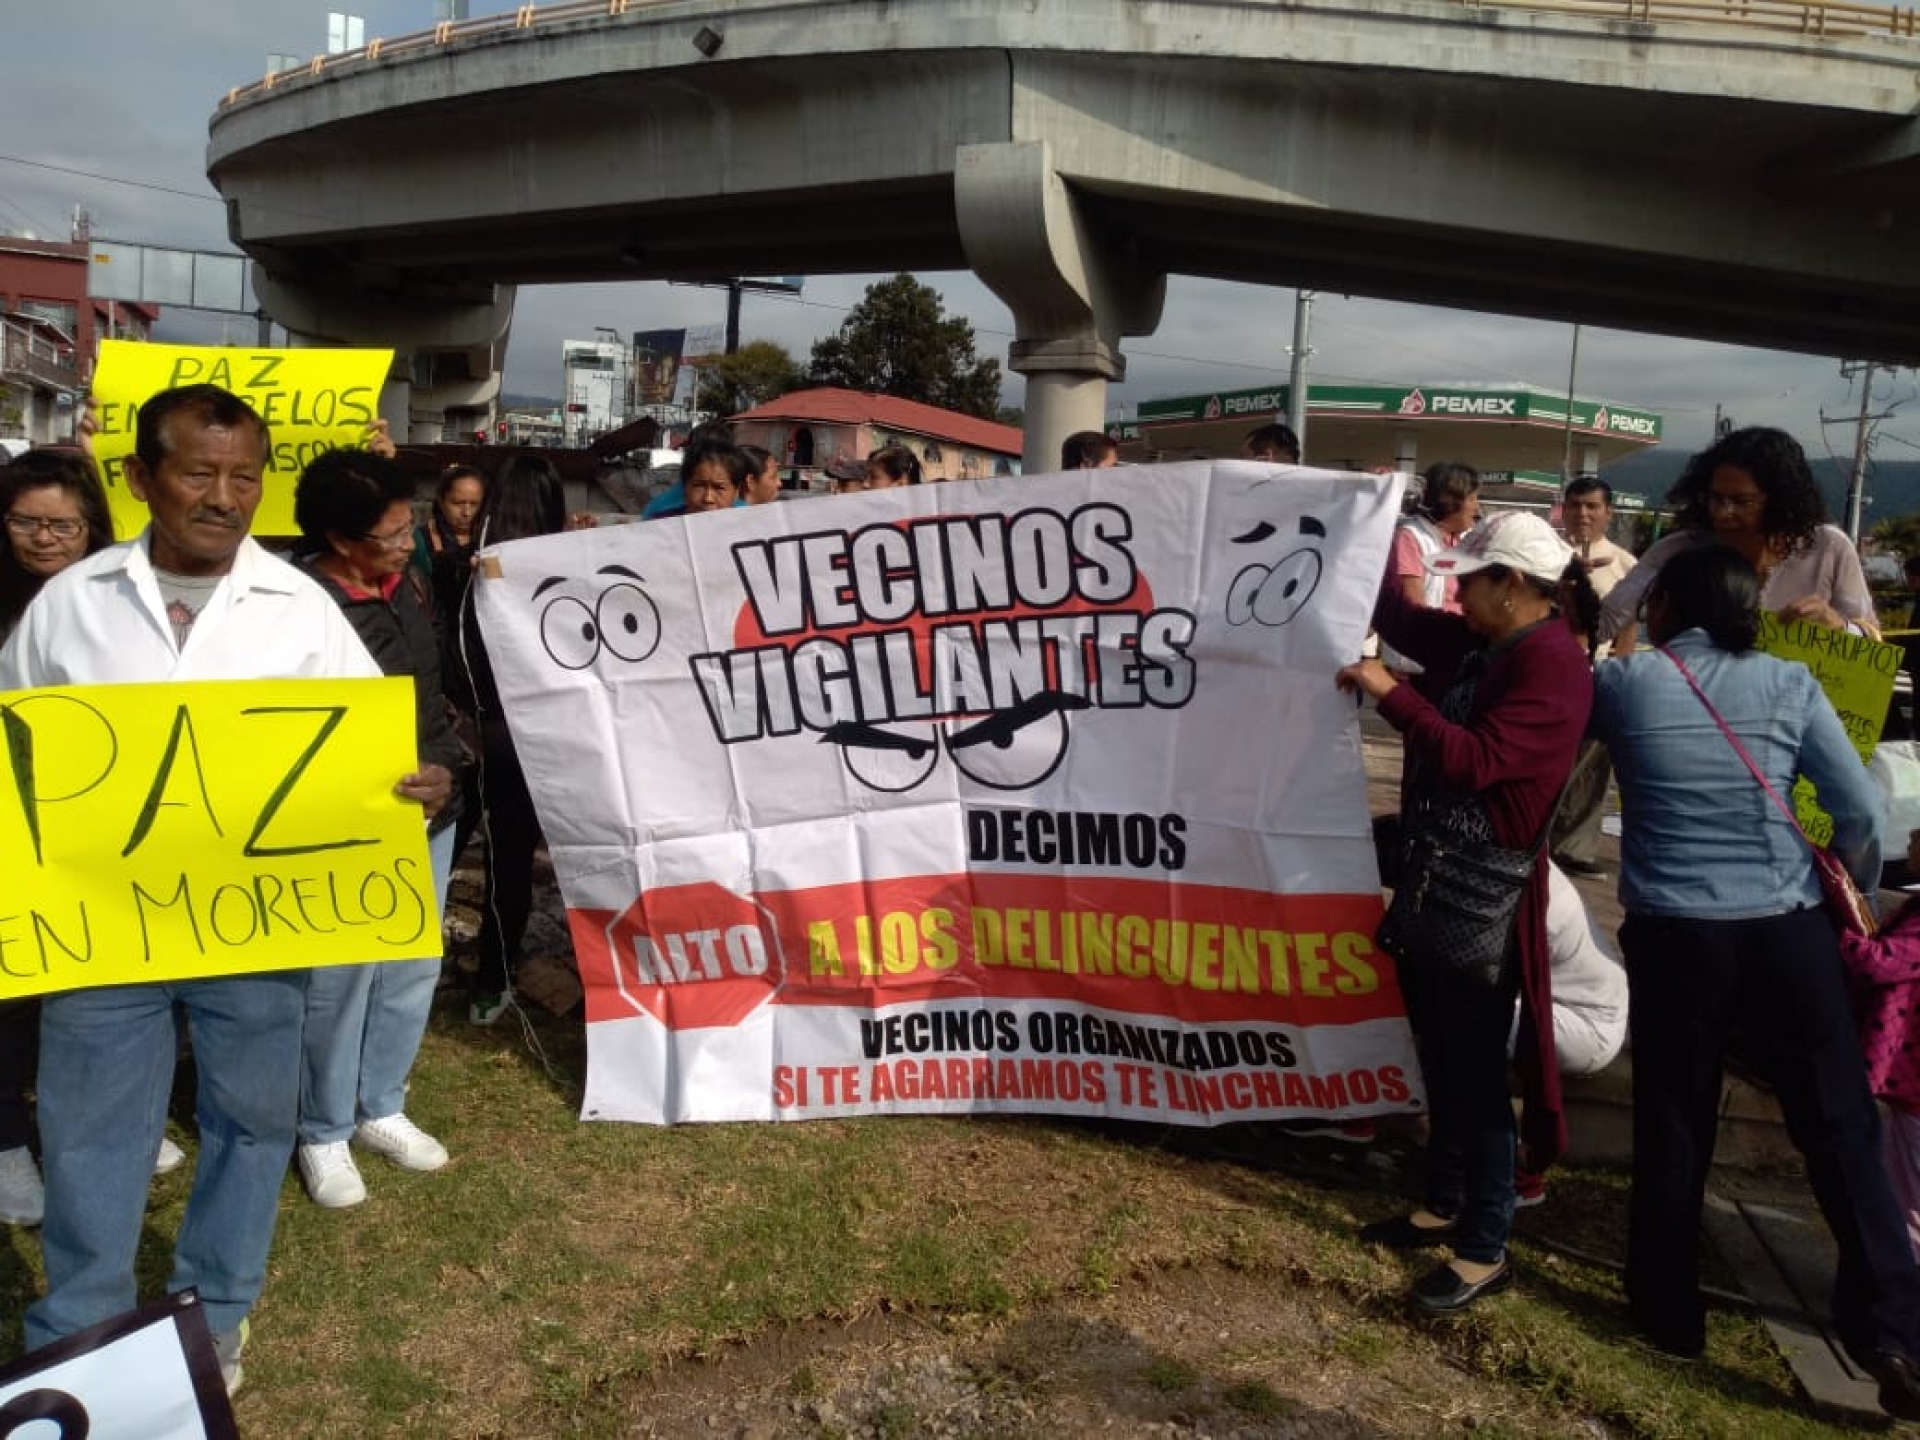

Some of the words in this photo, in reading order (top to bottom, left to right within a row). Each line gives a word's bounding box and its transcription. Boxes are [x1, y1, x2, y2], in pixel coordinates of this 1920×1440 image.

[170, 355, 284, 389] PAZ
[1225, 393, 1281, 414] PEMEX
[1433, 396, 1515, 415] PEMEX
[1611, 414, 1655, 434] PEMEX
[731, 502, 1138, 636] VECINOS
[690, 608, 1197, 744] VIGILANTES
[0, 694, 381, 867] PAZ
[968, 809, 1187, 869] DECIMOS
[132, 858, 425, 962] MORELOS
[632, 924, 769, 985] ALTO
[808, 919, 845, 976] A
[855, 907, 960, 976] LOS
[972, 907, 1378, 997] DELINCUENTES
[861, 1009, 1019, 1059] VECINOS
[1028, 1011, 1296, 1071] ORGANIZADOS
[773, 1065, 808, 1108] SI
[817, 1067, 860, 1105] TE
[870, 1057, 1107, 1102] AGARRAMOS
[1114, 1063, 1159, 1109] TE
